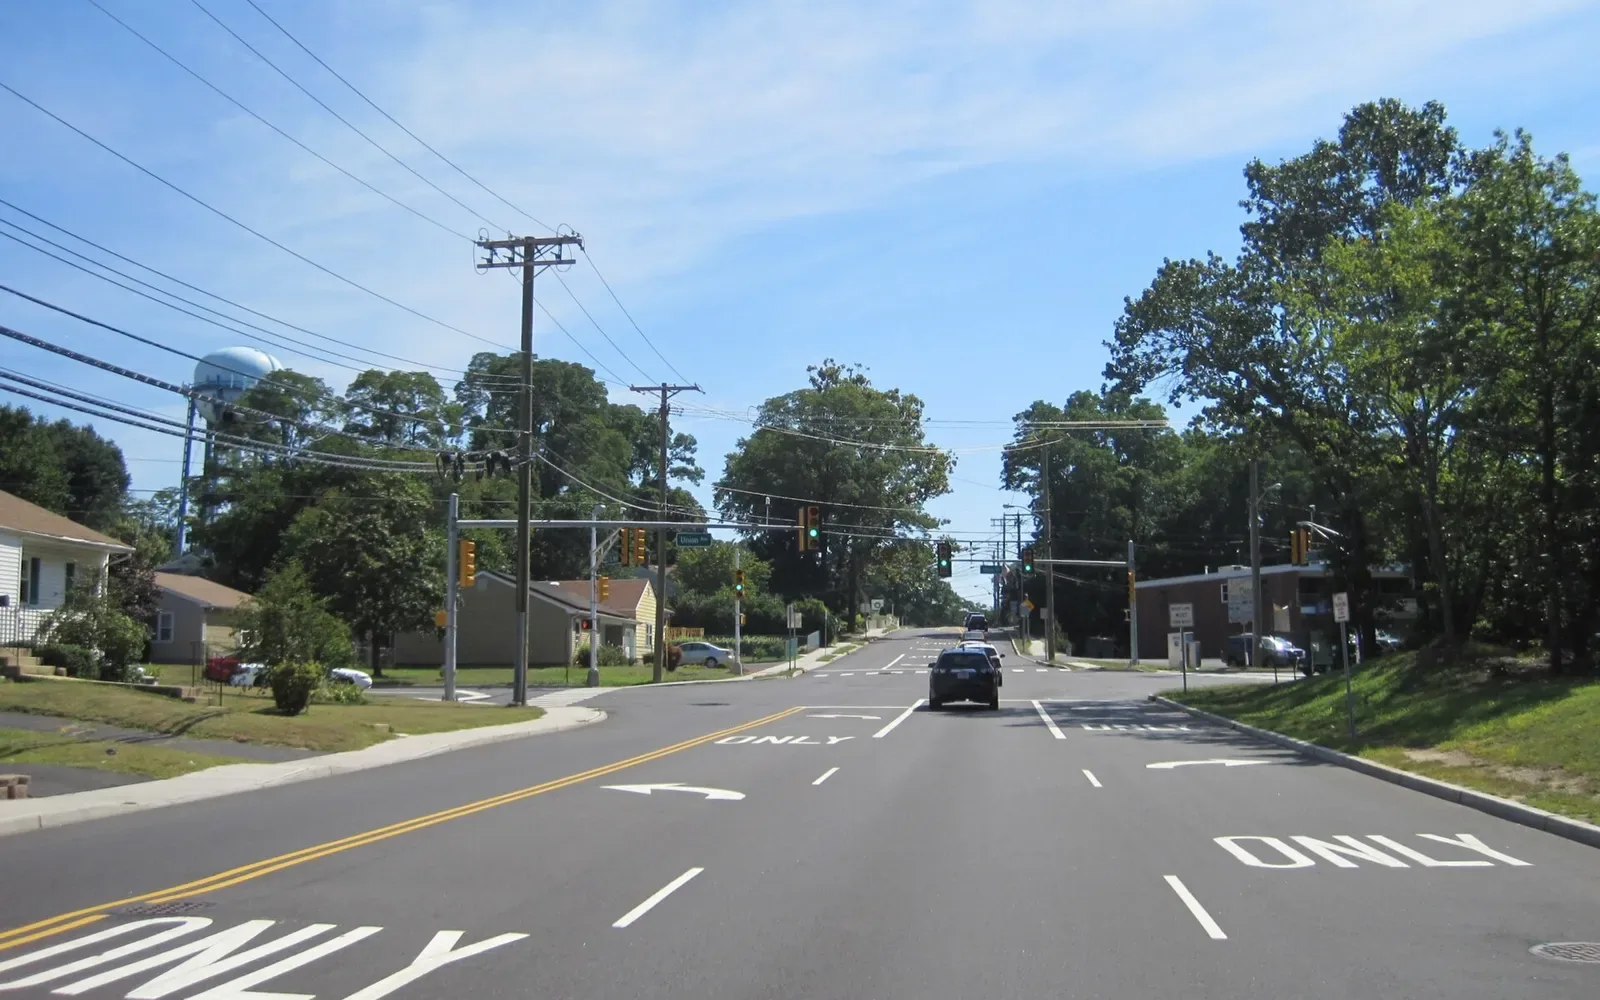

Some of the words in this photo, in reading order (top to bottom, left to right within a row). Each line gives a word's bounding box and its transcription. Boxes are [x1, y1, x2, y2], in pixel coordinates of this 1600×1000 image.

[680, 536, 699, 544] Union
[714, 736, 856, 744] ONLY
[1213, 833, 1534, 868] ONLY
[0, 917, 530, 1000] ONLY
